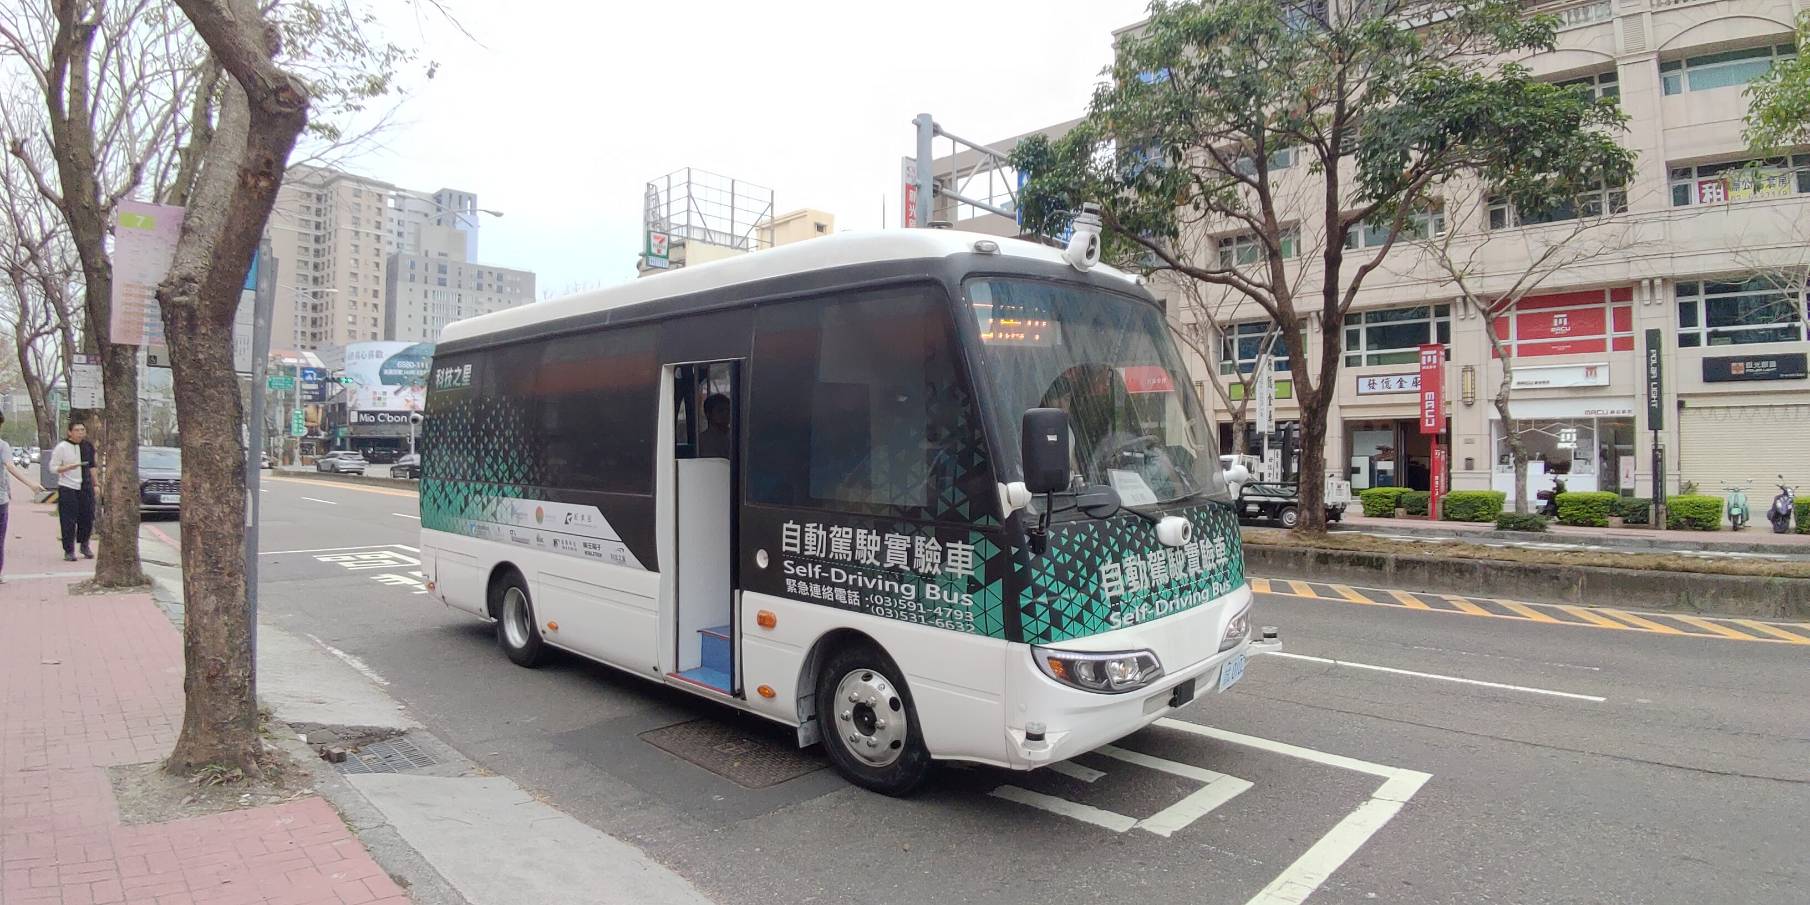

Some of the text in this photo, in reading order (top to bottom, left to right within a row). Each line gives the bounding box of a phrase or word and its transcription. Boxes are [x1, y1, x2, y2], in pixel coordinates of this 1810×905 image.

[1702, 183, 1725, 204] 租
[136, 215, 145, 227] 7
[436, 364, 472, 389] 科技之星
[359, 413, 408, 423] Mia C'bon
[782, 519, 975, 579] 自動駕駛實驗車
[1101, 536, 1229, 599] 自動駕駛實驗車
[783, 560, 974, 606] Self-Driving Bus
[785, 578, 860, 607] 緊急連絡電話
[871, 605, 976, 633] (03)531-6632
[1109, 580, 1232, 630] Self-Driving Bus
